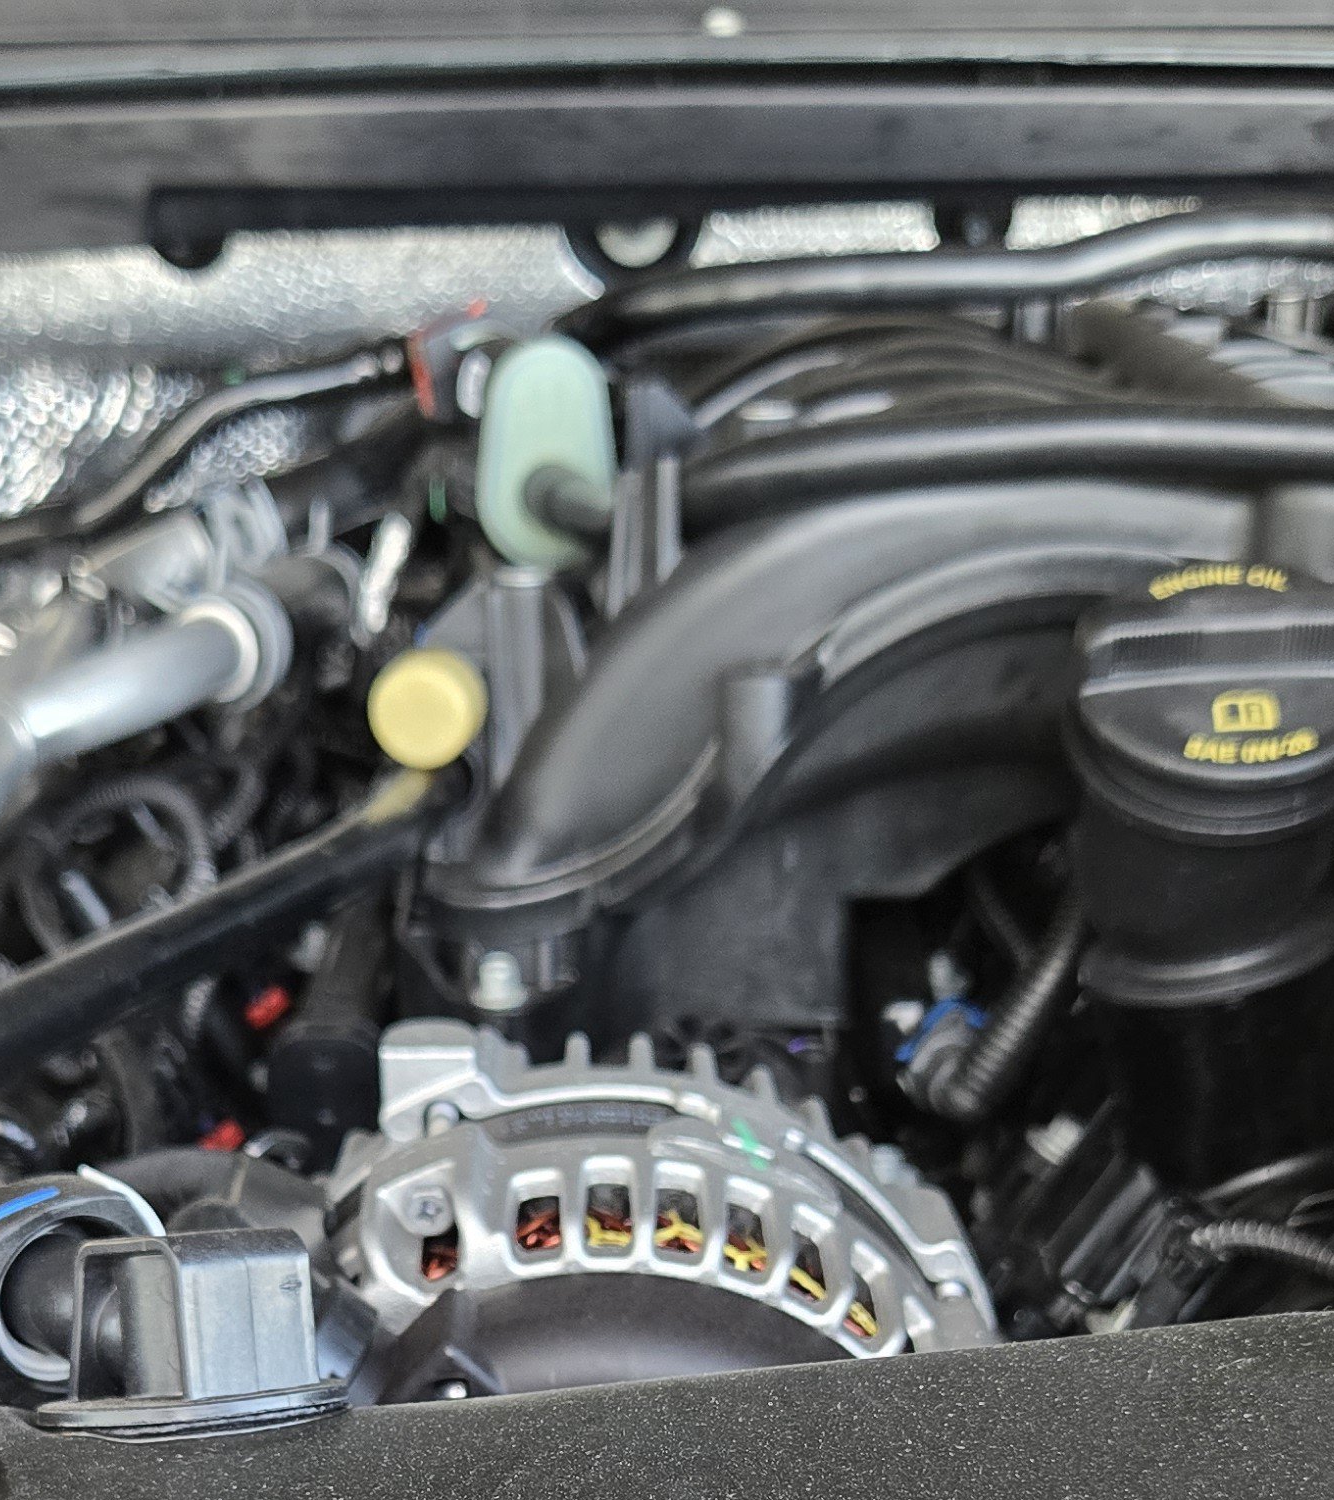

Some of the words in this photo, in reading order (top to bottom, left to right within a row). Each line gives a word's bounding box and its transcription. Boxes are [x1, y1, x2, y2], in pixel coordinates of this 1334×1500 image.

[1148, 563, 1241, 600] ENGINE
[1246, 563, 1289, 592] OIL
[1183, 733, 1238, 764] SAE
